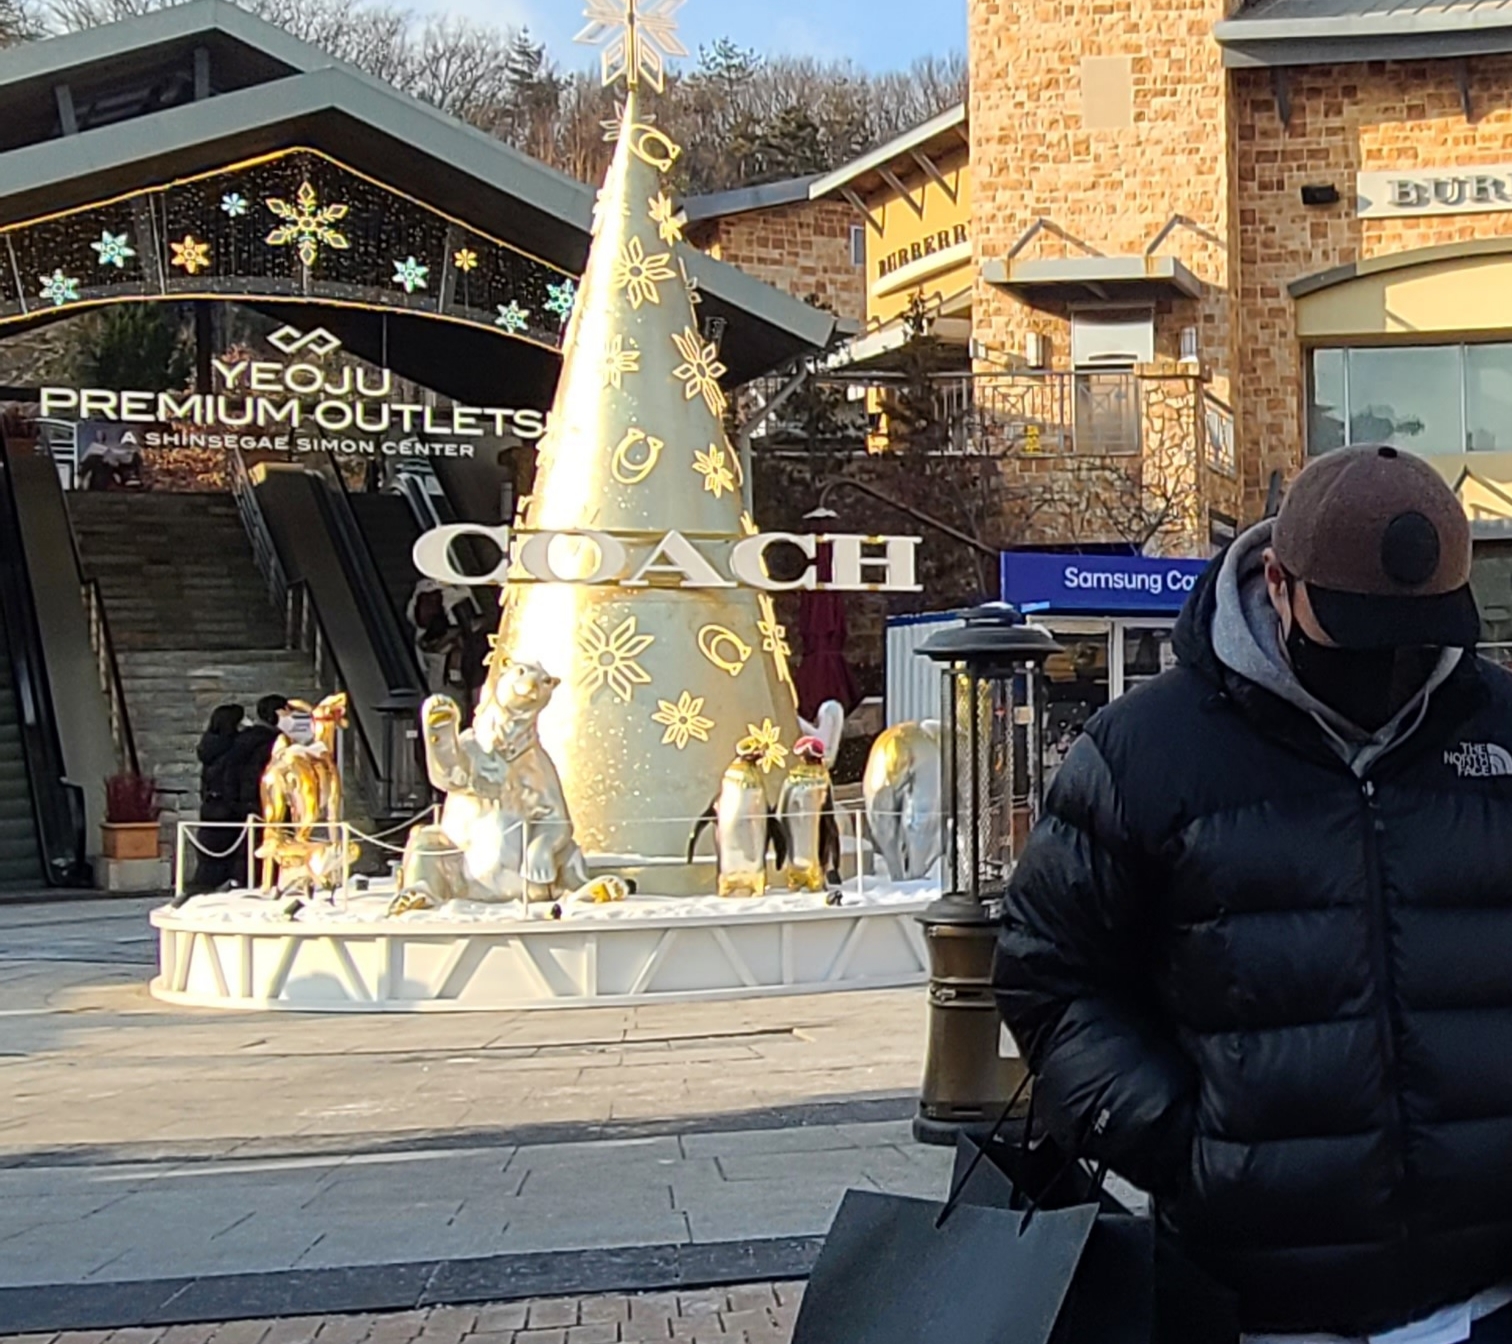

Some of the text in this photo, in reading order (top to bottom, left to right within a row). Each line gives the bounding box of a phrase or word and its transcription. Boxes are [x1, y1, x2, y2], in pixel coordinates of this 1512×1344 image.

[878, 218, 972, 279] BURBERR
[212, 358, 391, 396] YEOJU
[40, 387, 545, 439] PREMIUM OUTLETS
[120, 431, 475, 458] A SHINSEGAE SIMON CENTER
[412, 523, 925, 591] COACH
[1064, 566, 1162, 594] Samsung
[1459, 742, 1486, 755] THE
[1457, 765, 1491, 777] FACE
